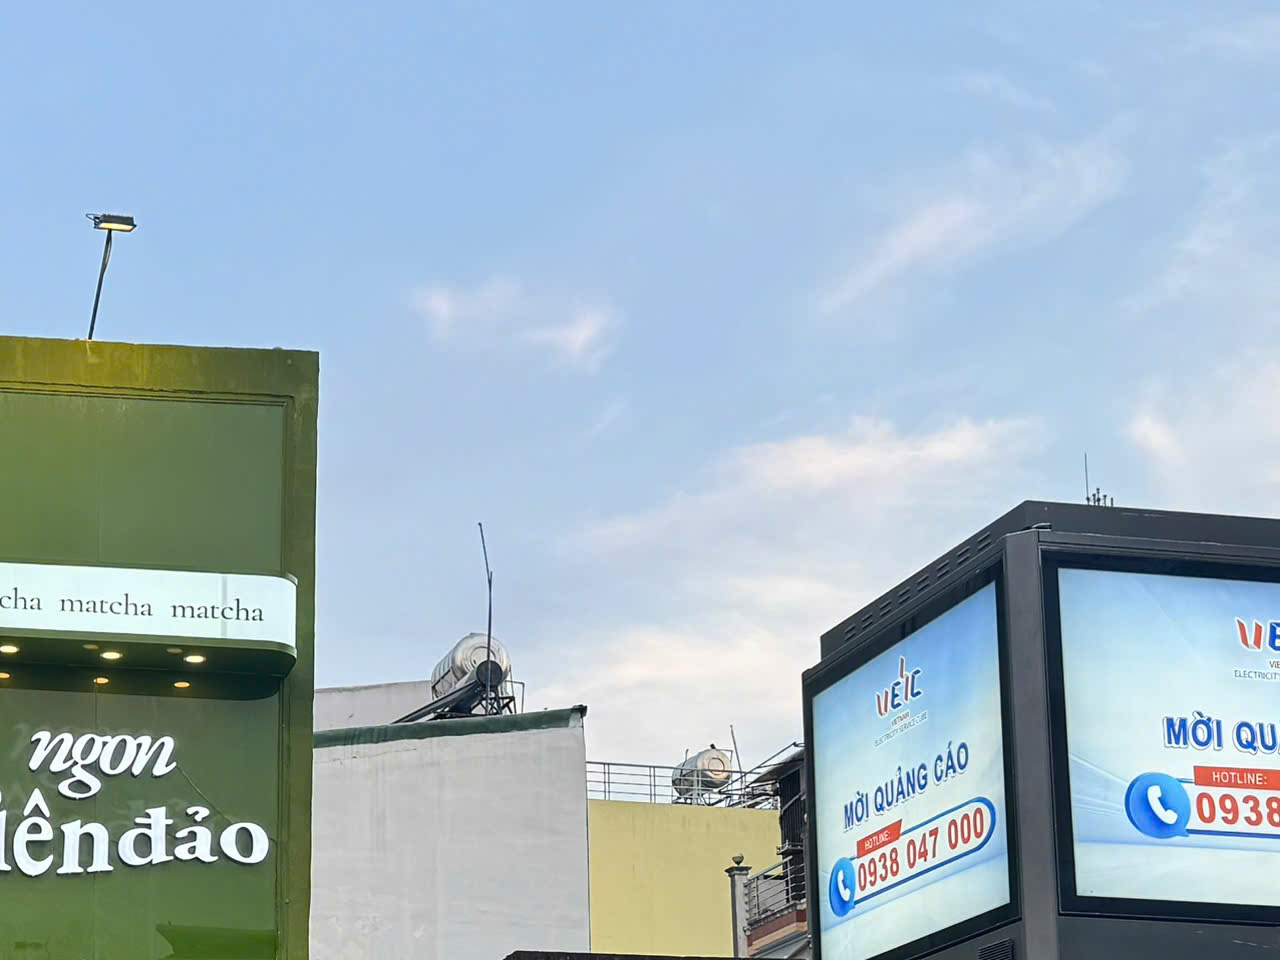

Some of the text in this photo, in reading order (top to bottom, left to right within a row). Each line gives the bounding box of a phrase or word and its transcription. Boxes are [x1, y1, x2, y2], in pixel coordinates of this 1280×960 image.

[59, 593, 153, 617] matcha
[170, 598, 264, 622] matcha
[1165, 711, 1280, 753] MỜI QU
[29, 729, 178, 800] ngon
[844, 741, 969, 830] MỜI QUẢNG CÁO
[1211, 771, 1268, 785] HOTLINE:
[1196, 792, 1280, 828] 0938
[117, 806, 270, 867] đảo
[858, 807, 984, 892] 0938 047 000
